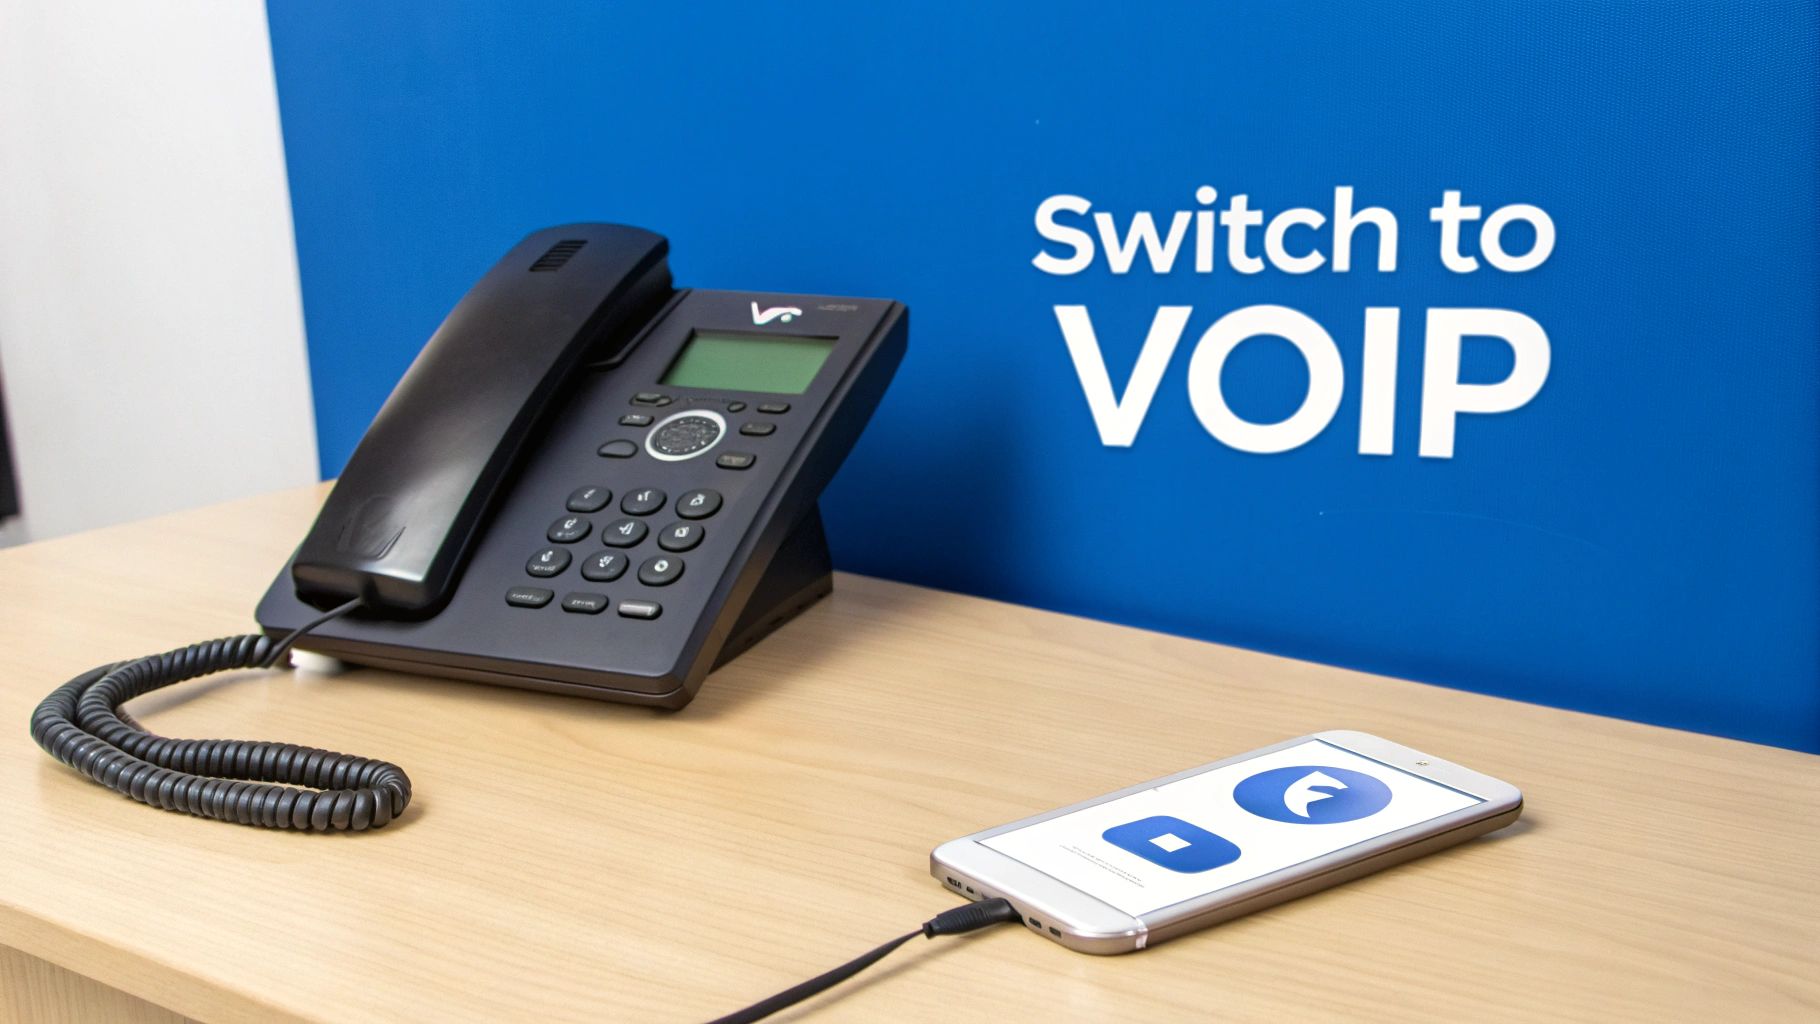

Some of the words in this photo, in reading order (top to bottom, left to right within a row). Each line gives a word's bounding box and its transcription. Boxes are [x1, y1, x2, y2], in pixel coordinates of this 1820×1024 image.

[1032, 185, 1398, 275] Switch
[1431, 190, 1556, 275] to
[1054, 304, 1551, 458] VOIP
